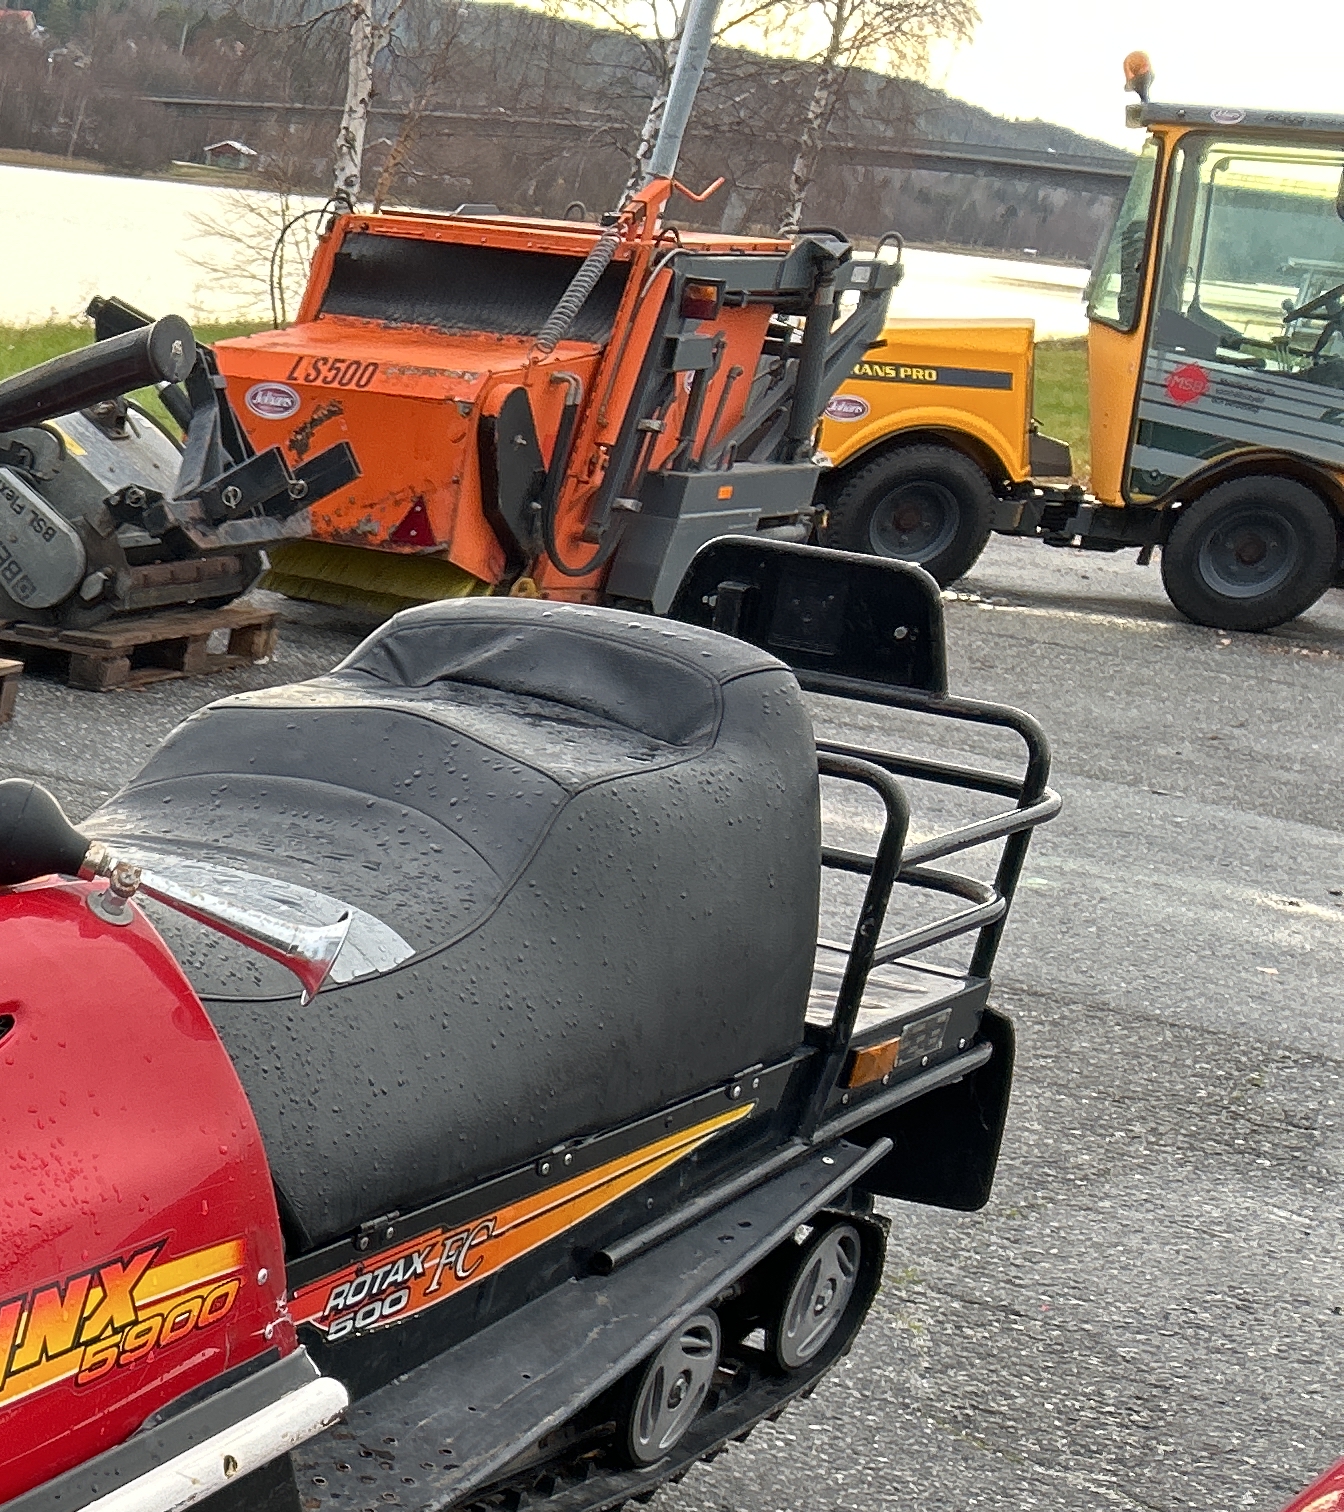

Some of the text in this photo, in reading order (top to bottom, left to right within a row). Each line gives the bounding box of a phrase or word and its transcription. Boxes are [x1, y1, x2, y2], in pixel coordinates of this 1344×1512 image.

[286, 355, 379, 389] LS500
[899, 366, 938, 382] PRO
[1170, 375, 1204, 394] MSB
[28, 509, 58, 544] BSL
[322, 1216, 497, 1319] ROTAX FC
[326, 1286, 411, 1342] 500
[75, 1277, 243, 1388] 5900
